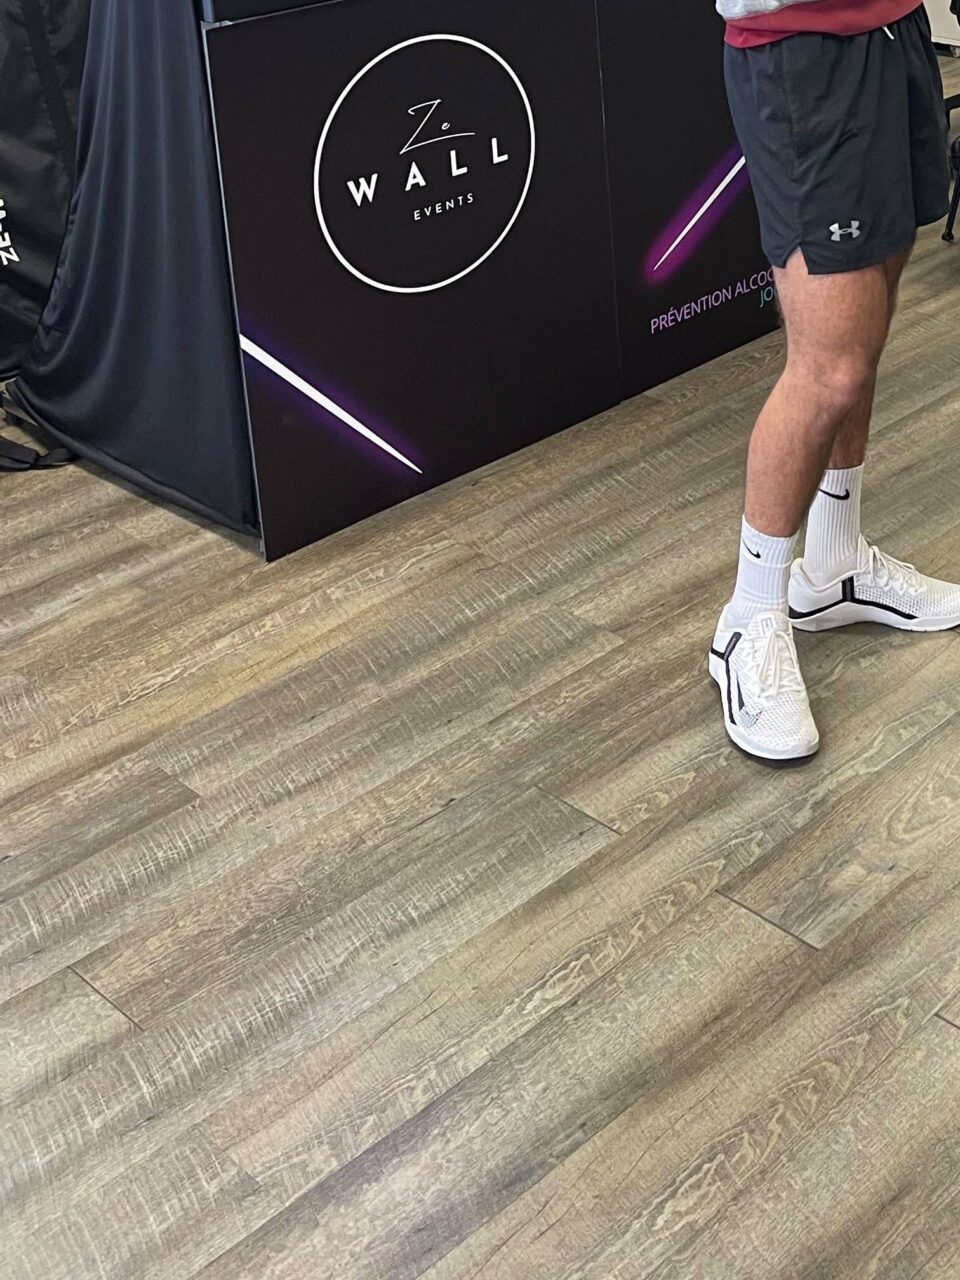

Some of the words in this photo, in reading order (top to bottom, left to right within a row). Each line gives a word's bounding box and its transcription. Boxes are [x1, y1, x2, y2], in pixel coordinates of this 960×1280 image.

[399, 99, 476, 155] Ze
[346, 137, 509, 207] WALL
[413, 193, 474, 221] EVENTS
[650, 285, 732, 334] PRÉVENTION
